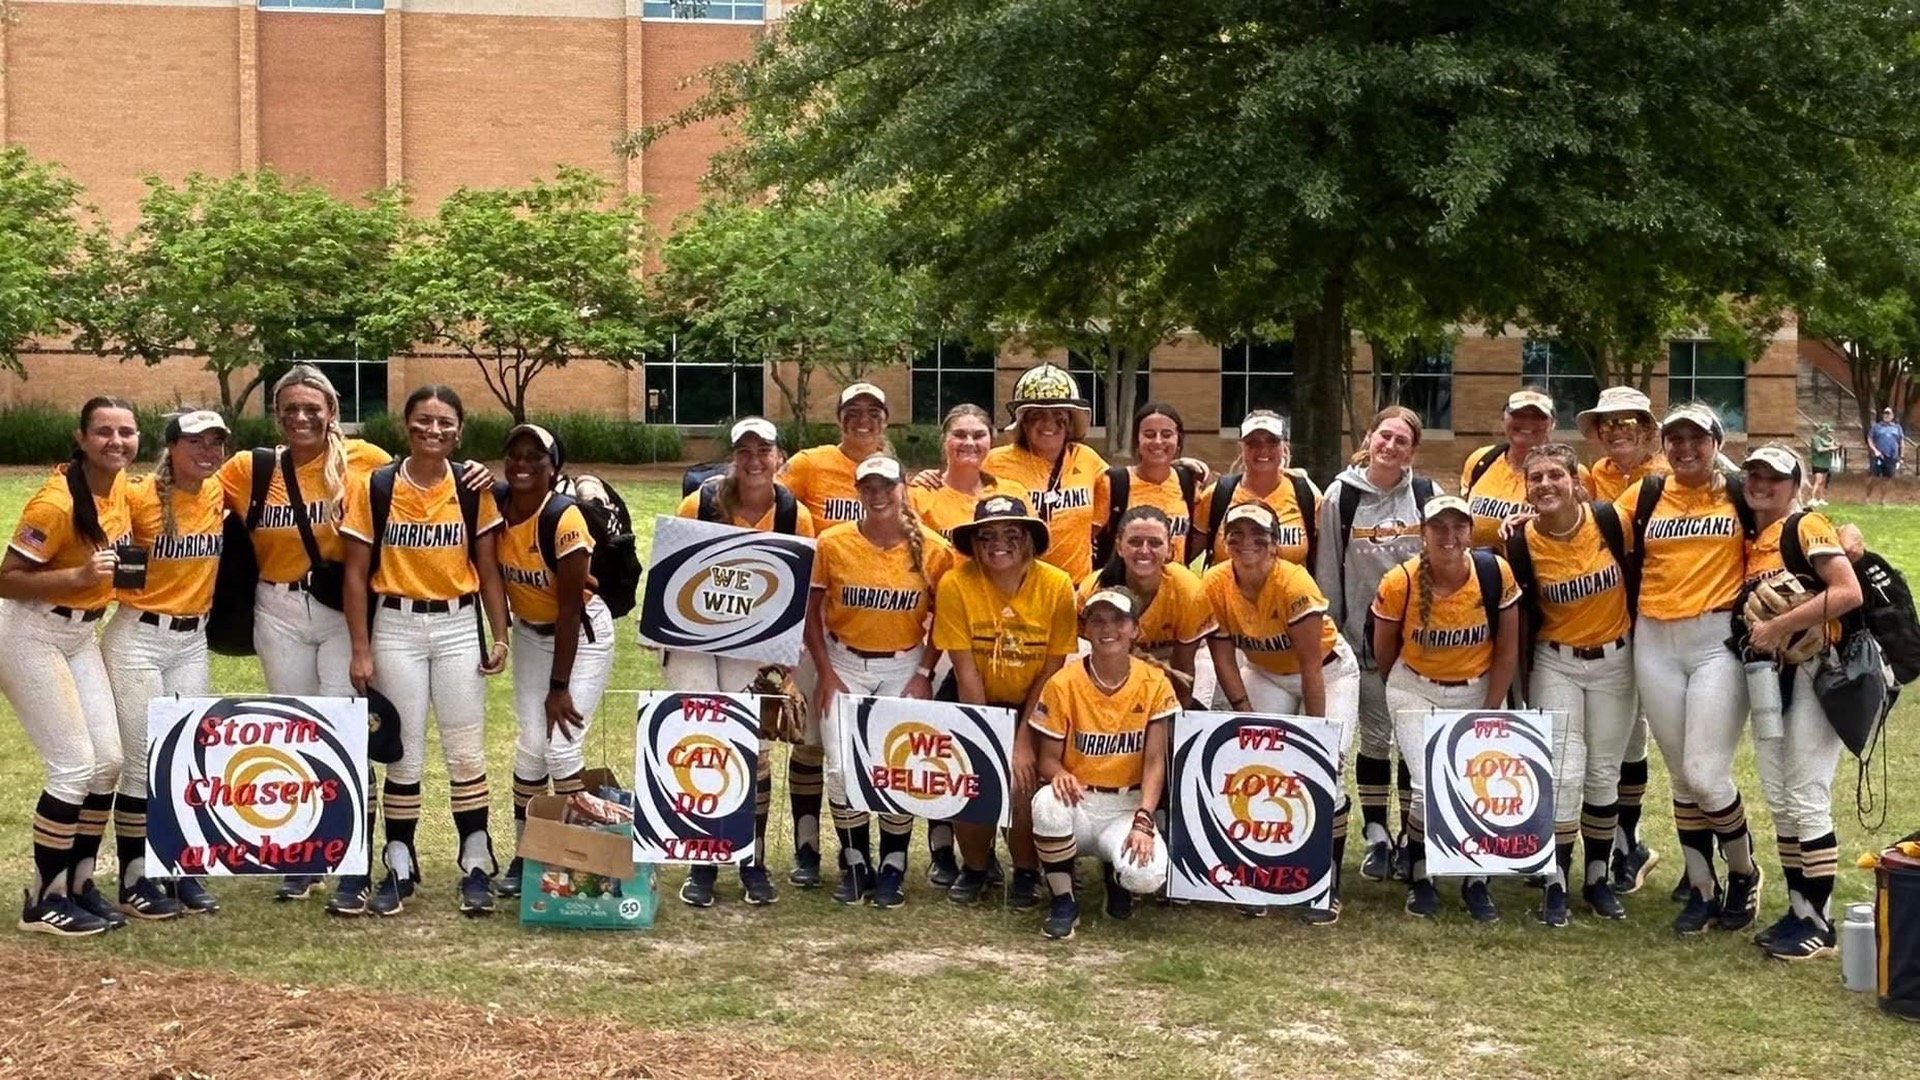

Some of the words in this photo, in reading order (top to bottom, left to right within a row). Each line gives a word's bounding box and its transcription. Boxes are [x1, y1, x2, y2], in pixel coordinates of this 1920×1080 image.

[711, 567, 751, 590] WE
[703, 591, 754, 615] WIN
[682, 696, 729, 722] WE
[200, 716, 319, 747] Storm
[1238, 727, 1287, 750] WE
[1474, 720, 1511, 738] WE
[908, 732, 953, 758] WE
[667, 746, 731, 770] CAN
[1464, 758, 1528, 778] LOVE
[871, 766, 981, 799] BELIEVE
[1220, 773, 1303, 797] LOVE
[675, 792, 719, 816] DO
[1473, 796, 1523, 820] OUR
[1228, 819, 1294, 844] OUR
[180, 843, 247, 870] are
[257, 836, 345, 867] here
[1460, 834, 1540, 857] CANES
[1209, 864, 1310, 889] CANES
[620, 901, 640, 915] 50
